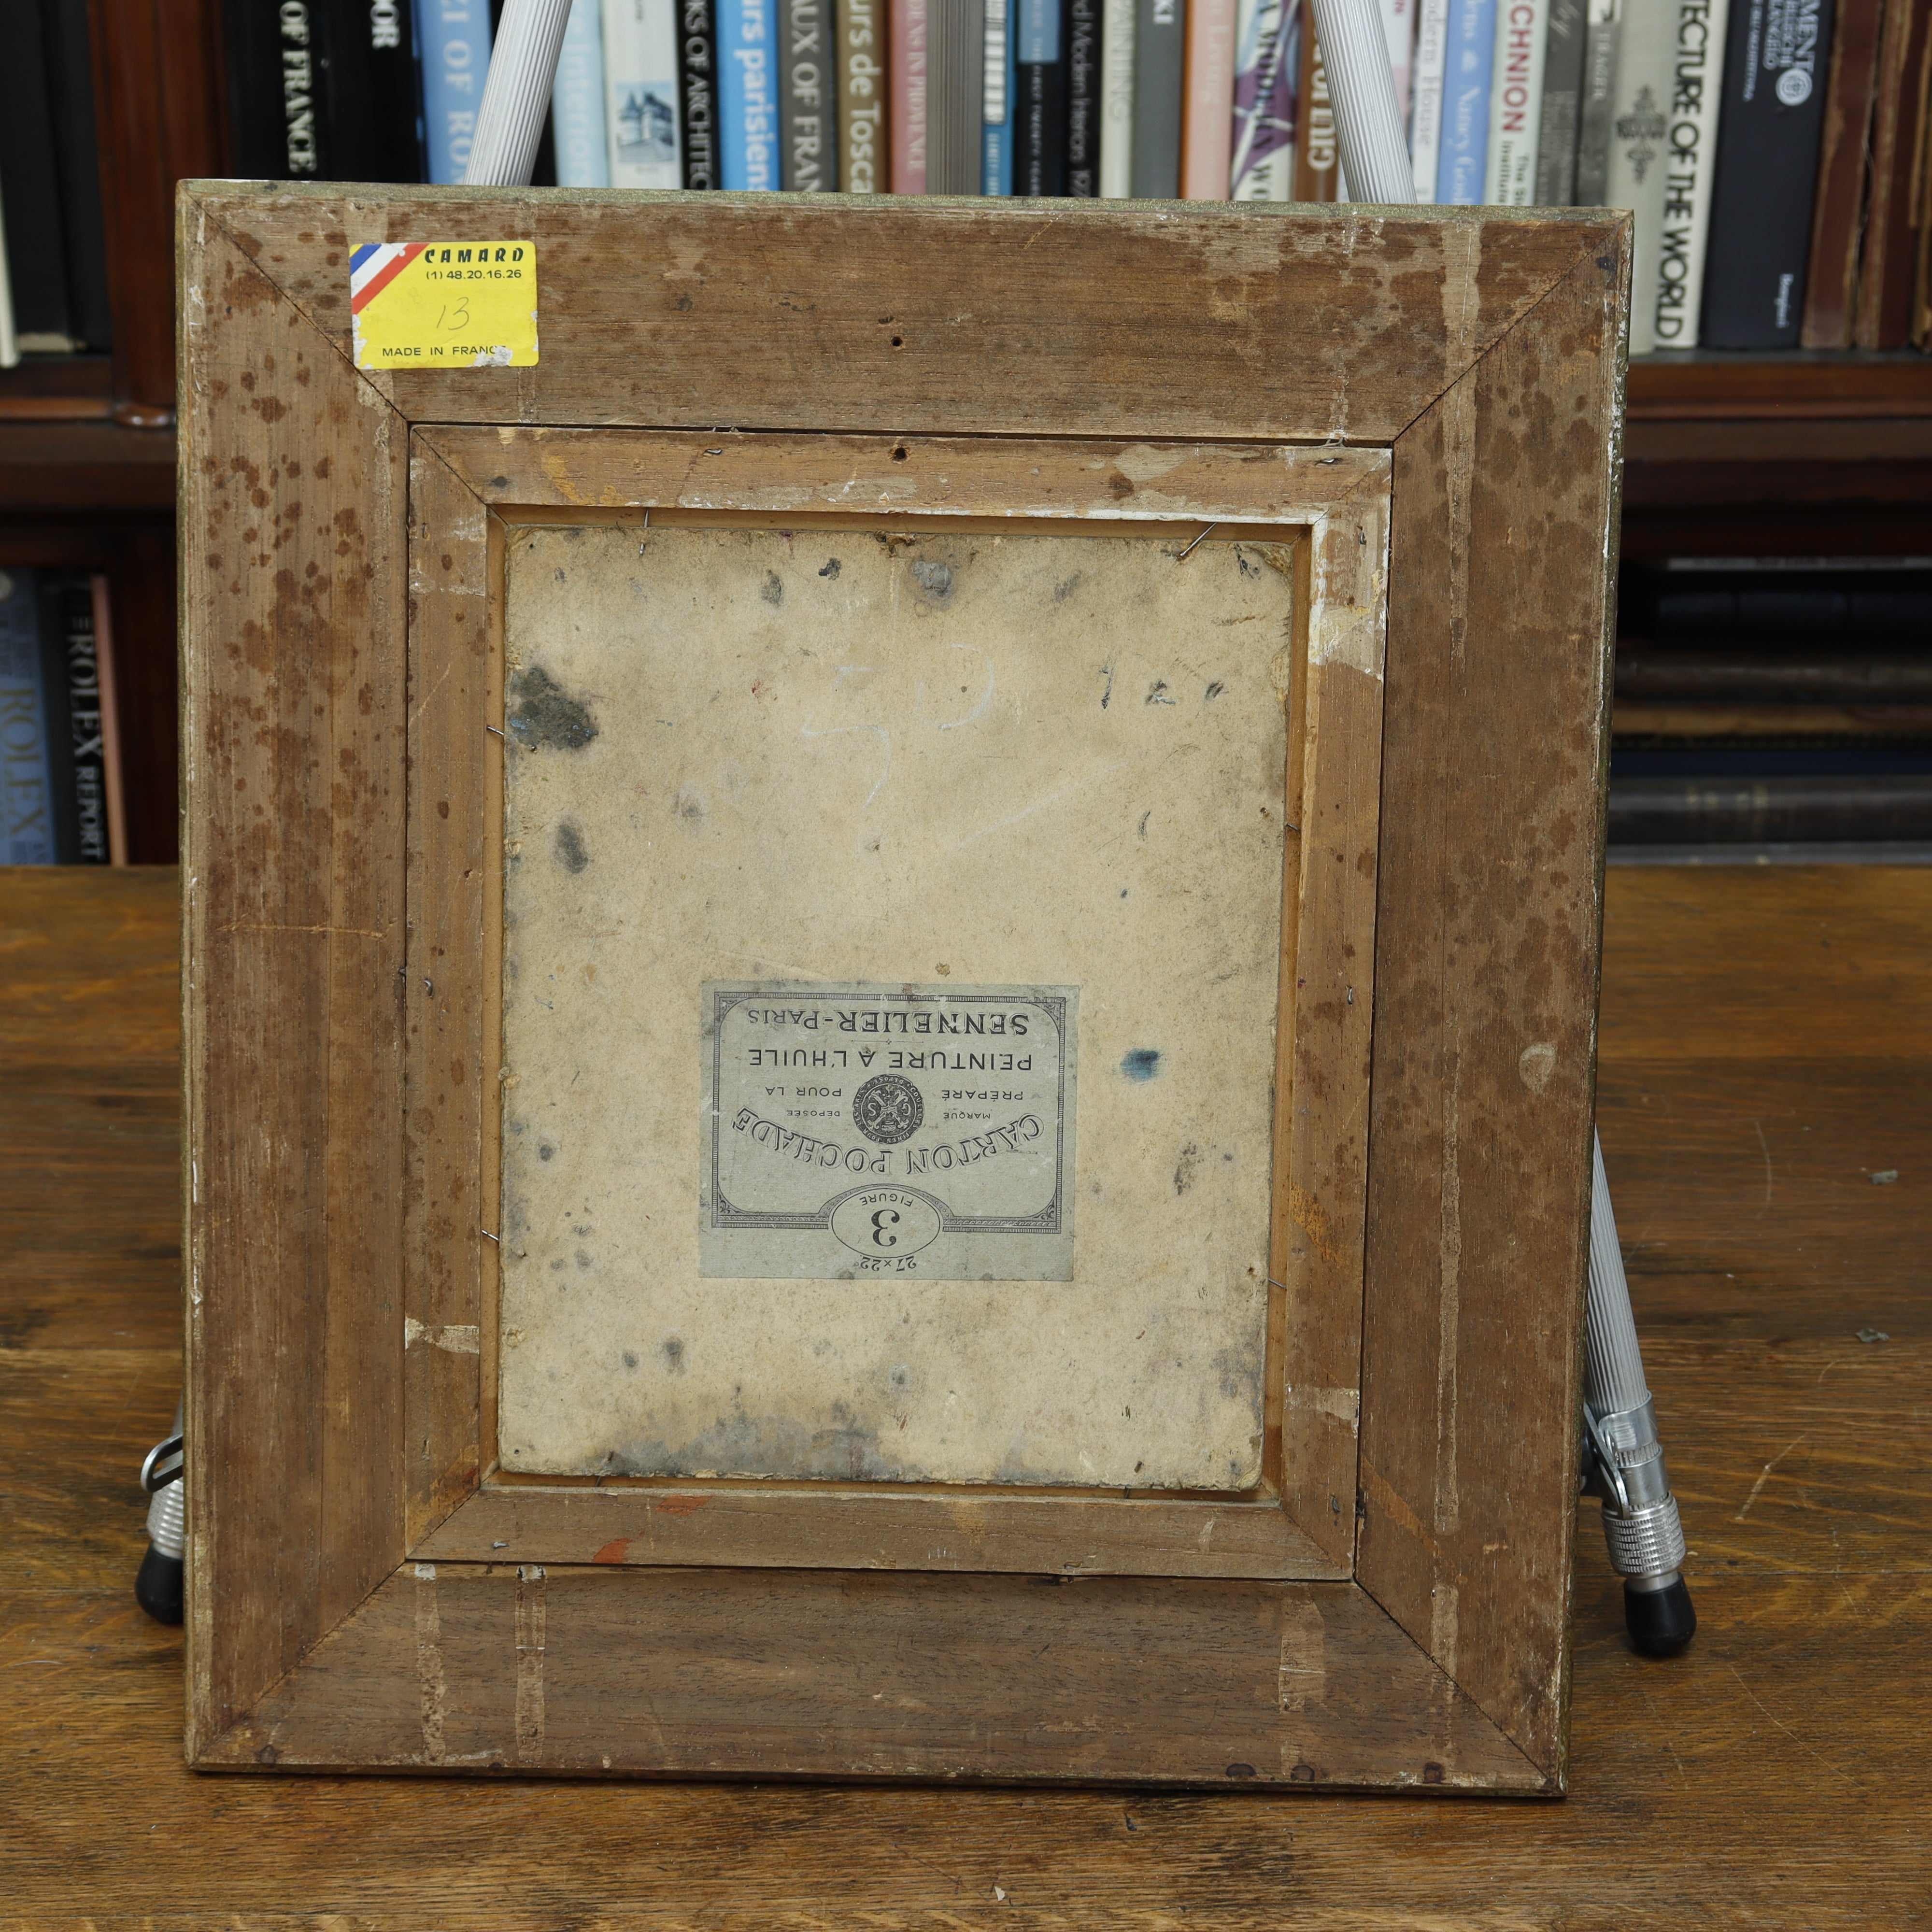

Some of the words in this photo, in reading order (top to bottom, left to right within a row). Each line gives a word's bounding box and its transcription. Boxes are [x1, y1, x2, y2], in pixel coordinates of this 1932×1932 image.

[280, 1, 310, 44] OF
[370, 0, 400, 48] OR
[443, 40, 474, 94] OF
[685, 37, 710, 71] OF
[849, 54, 882, 97] de
[1071, 22, 1094, 96] Modern
[1109, 0, 1134, 124] AINTING
[1674, 0, 1710, 114] ECTURE
[792, 63, 821, 108] OF
[283, 50, 317, 172] FRANCE
[906, 76, 926, 175] PROVENCE
[1030, 104, 1042, 157] TWENTY
[1419, 76, 1441, 149] House
[849, 100, 881, 193] Tosca
[1668, 121, 1700, 164] OF
[1665, 171, 1697, 219] THE
[425, 248, 524, 263] CAMARD
[426, 270, 443, 280] (1)
[446, 270, 522, 280] 48.20.16.26
[1655, 227, 1692, 339] WORLD
[436, 297, 469, 331] 13
[383, 347, 421, 356] MADE
[430, 347, 443, 355] IN
[453, 346, 507, 355] FRANC
[68, 634, 103, 760] ROLEX
[0, 687, 46, 836] ROLEX
[76, 766, 105, 860] REPORT
[748, 1049, 847, 1068] L'HUILE
[858, 1050, 876, 1067] A
[888, 1051, 1032, 1070] PEINTURE
[765, 1086, 784, 1096] LA
[796, 1087, 842, 1097] POUR
[867, 1102, 877, 1116] S
[902, 1103, 911, 1116] G
[942, 1089, 1023, 1101] PRÉPARÉ
[732, 1107, 895, 1175] POCHADE
[863, 1128, 880, 1142] POUR
[886, 1132, 909, 1143] FINES
[906, 1113, 1045, 1175] CARTON
[860, 1193, 914, 1208] FIGURE
[871, 1209, 900, 1247] 3
